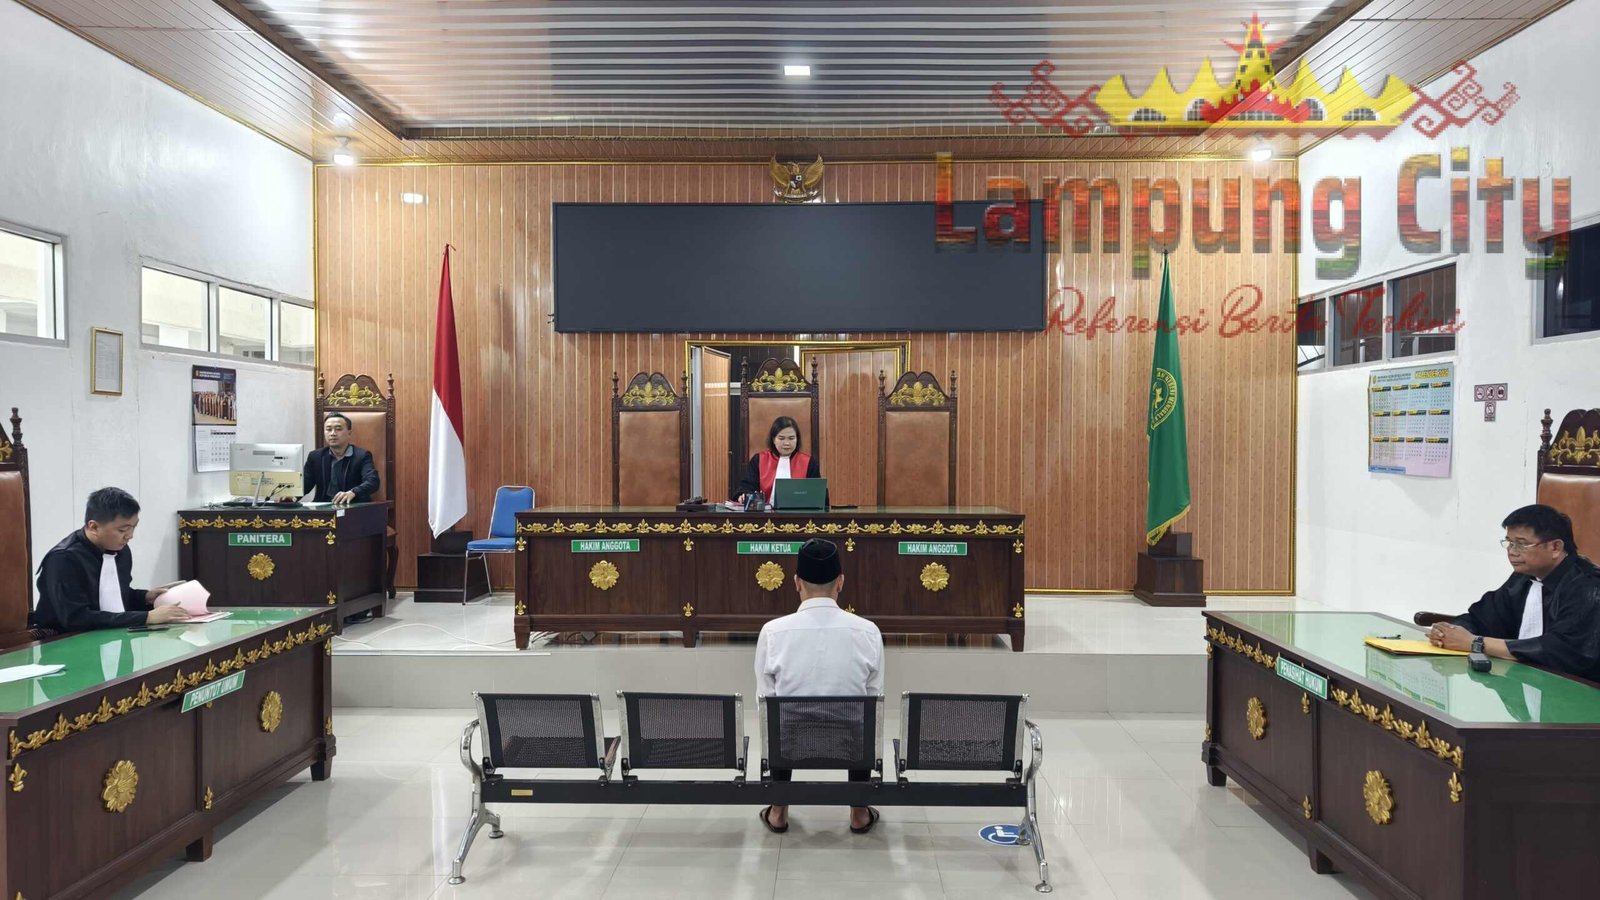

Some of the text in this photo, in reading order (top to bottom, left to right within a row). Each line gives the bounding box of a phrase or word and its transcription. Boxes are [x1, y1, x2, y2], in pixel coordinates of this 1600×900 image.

[236, 534, 286, 544] PANITERA
[580, 541, 631, 551] HAKIM ANGGOTA
[749, 543, 792, 553] HAKIM KETUA
[907, 543, 958, 553] HAKIM ANGGOTA
